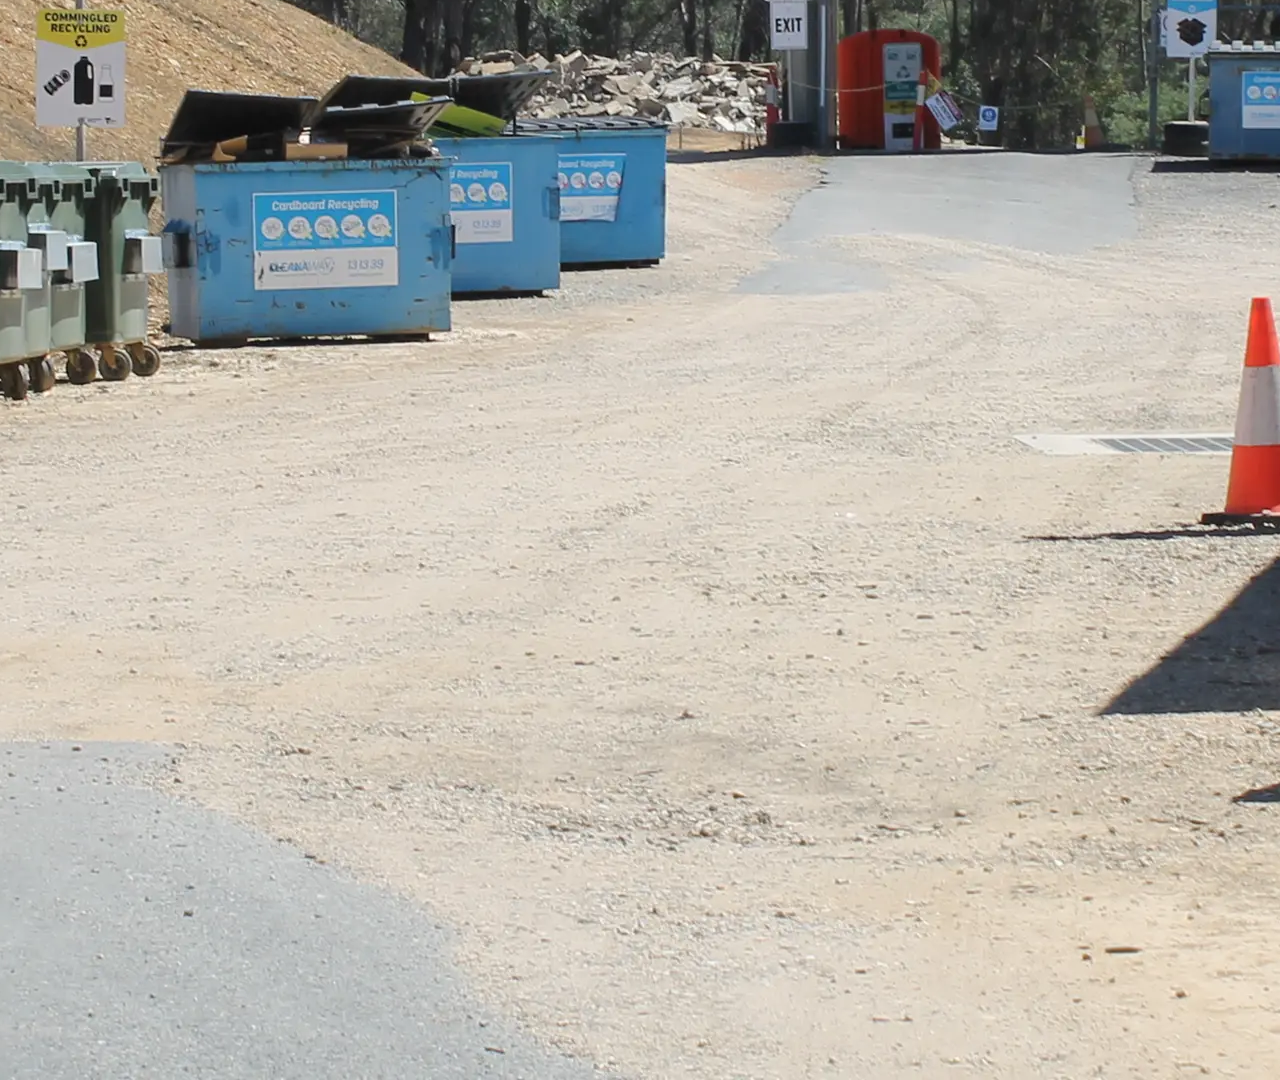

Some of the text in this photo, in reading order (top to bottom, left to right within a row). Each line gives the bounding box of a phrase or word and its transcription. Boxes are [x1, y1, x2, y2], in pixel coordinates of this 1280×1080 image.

[44, 12, 118, 22] COMMINGLED
[50, 23, 111, 33] RECYCLING
[775, 17, 803, 33] EXIT
[272, 198, 380, 211] Cardboard Recycling
